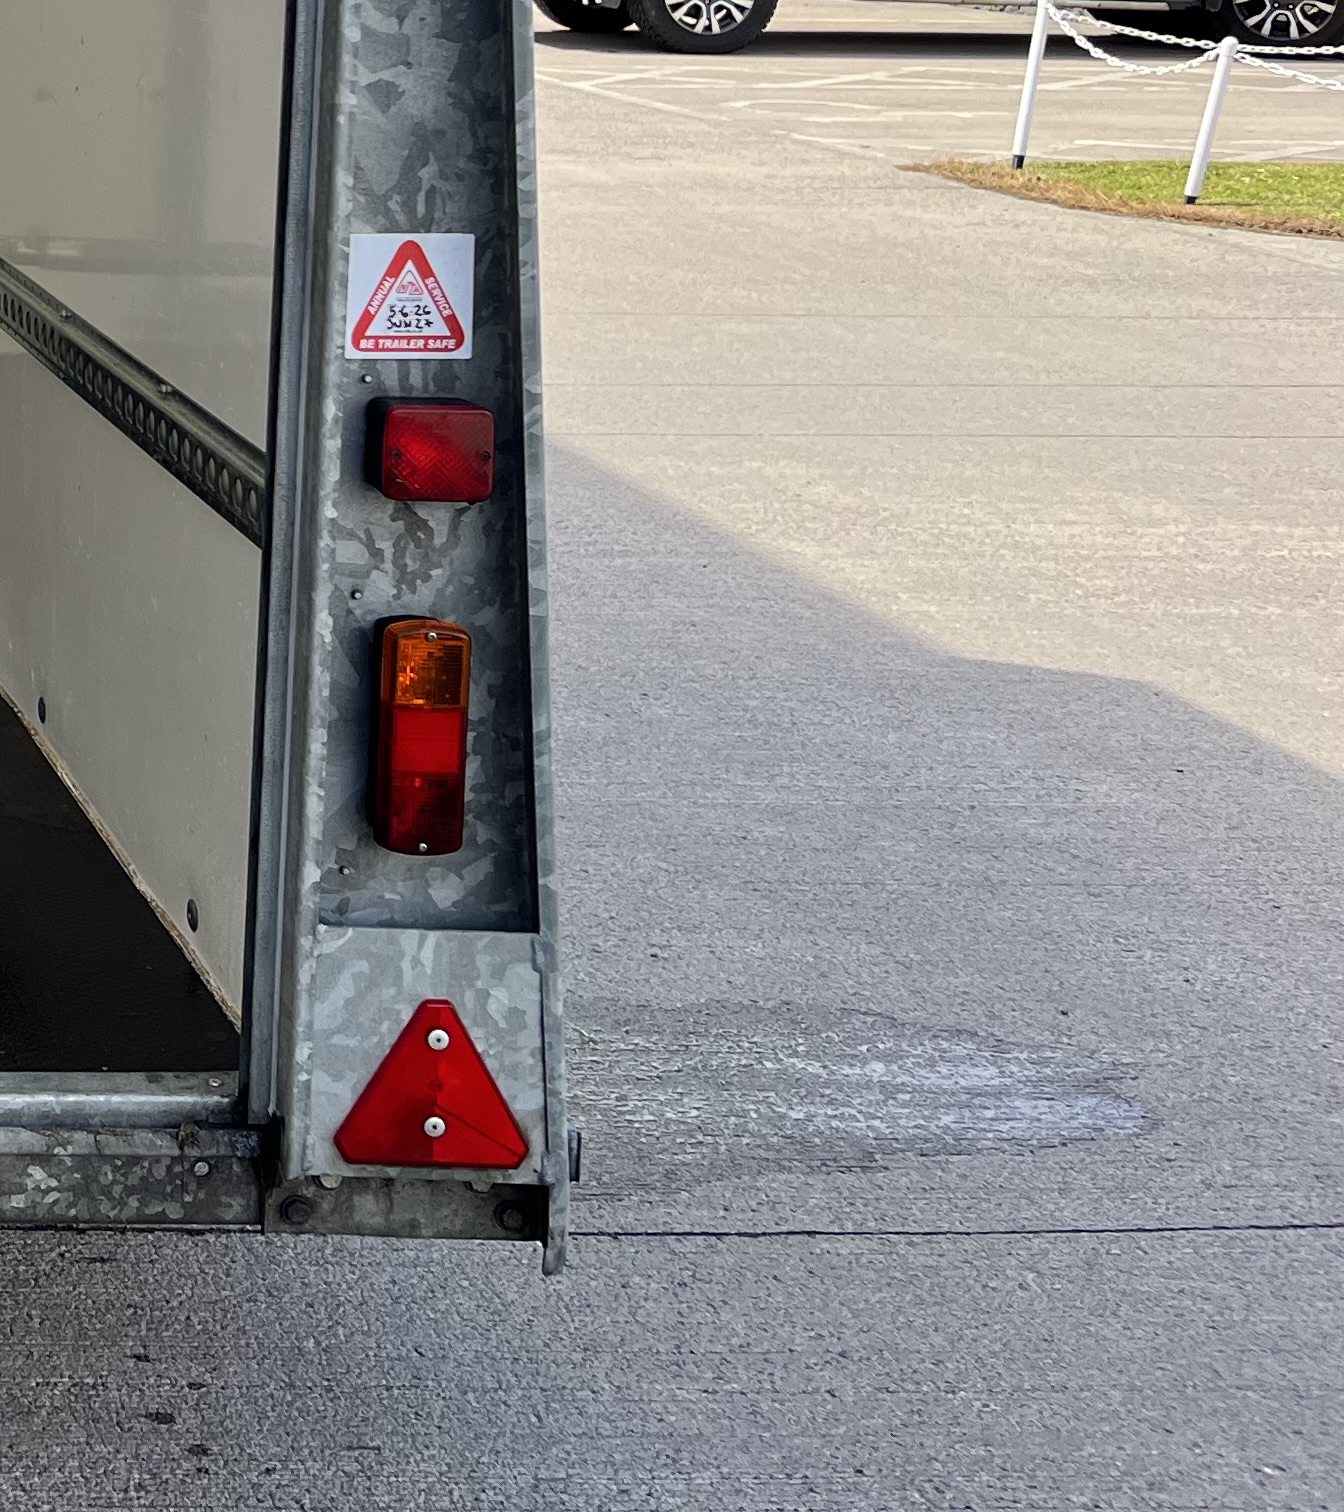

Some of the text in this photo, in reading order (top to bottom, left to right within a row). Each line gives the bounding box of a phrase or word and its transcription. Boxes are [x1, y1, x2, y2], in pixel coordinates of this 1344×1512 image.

[367, 276, 395, 316] ANNUAL
[424, 276, 454, 318] SERVICE
[359, 338, 457, 349] BE TRAILER SAFE
